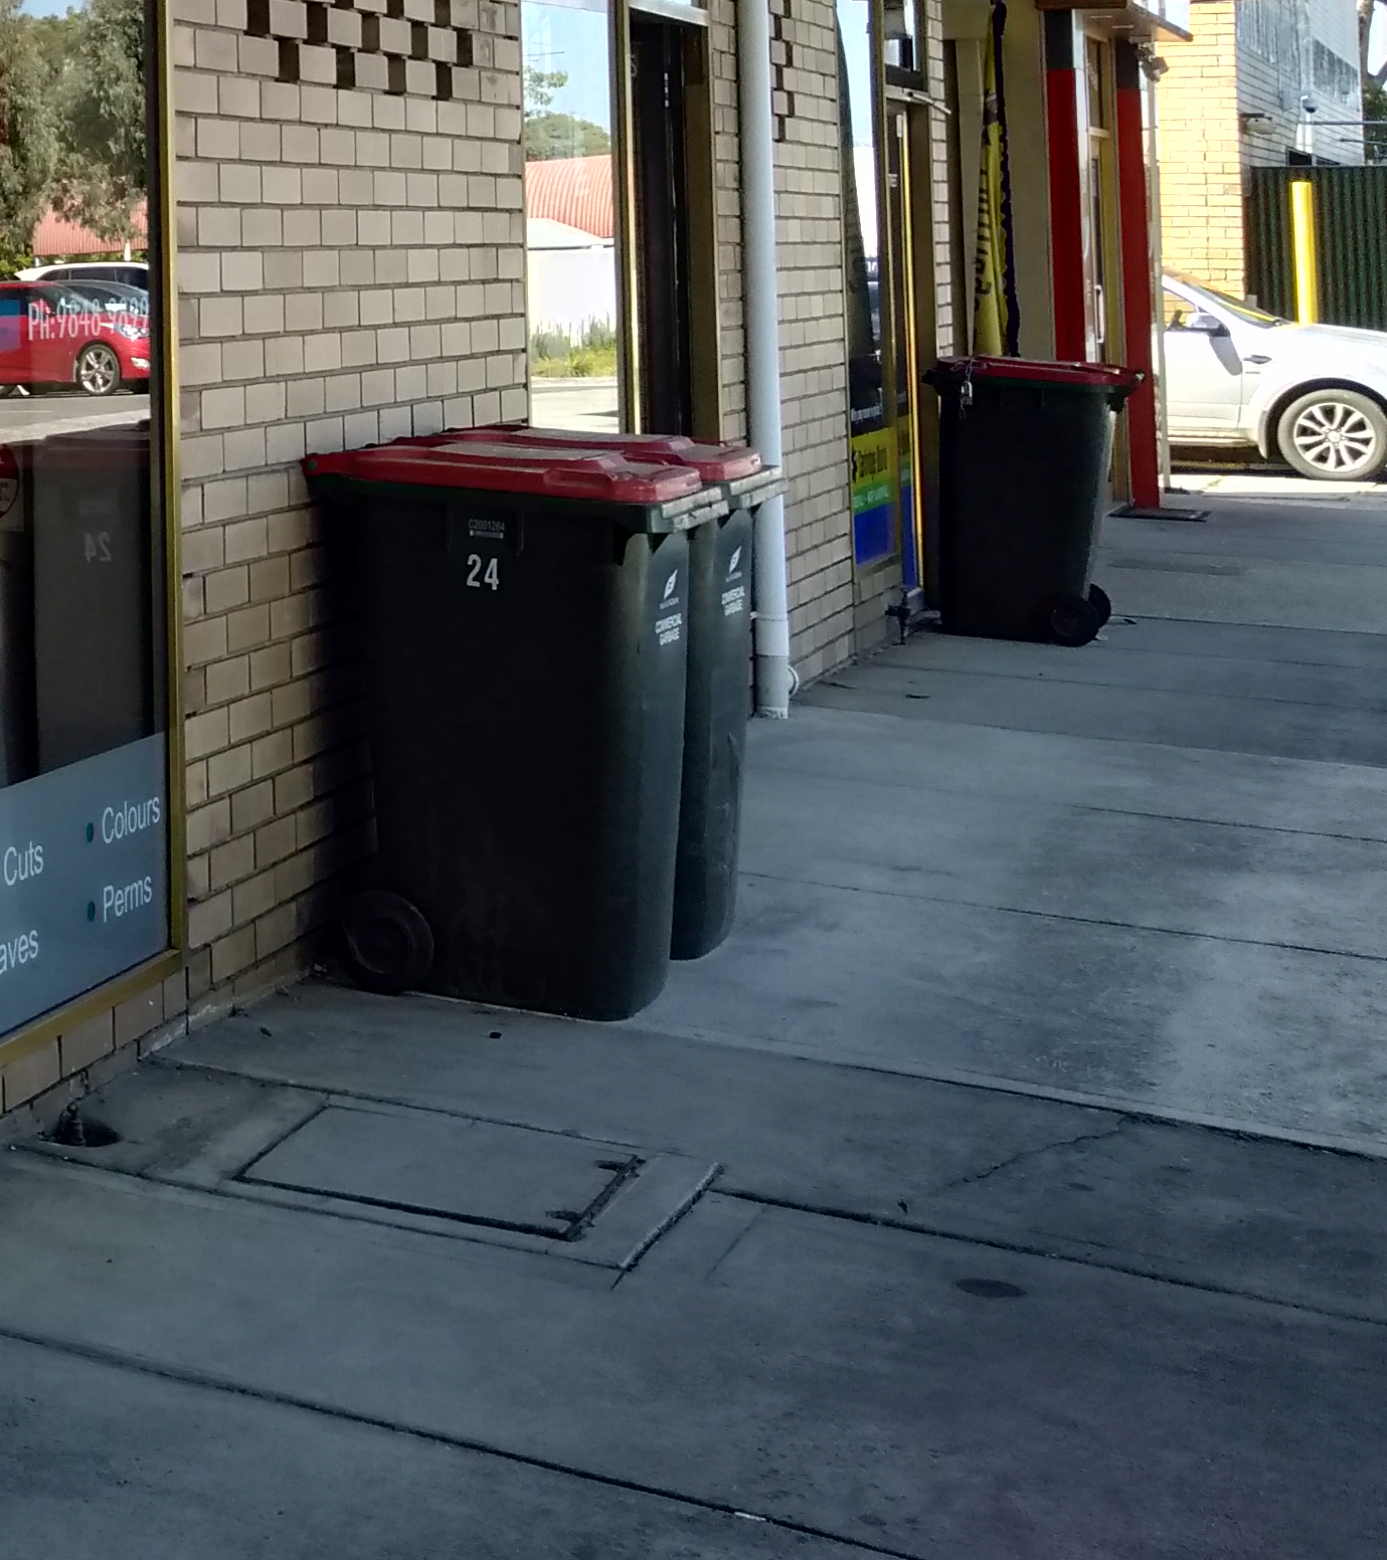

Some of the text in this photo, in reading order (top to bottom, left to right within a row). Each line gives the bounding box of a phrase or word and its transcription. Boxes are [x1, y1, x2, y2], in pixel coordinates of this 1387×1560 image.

[466, 553, 500, 591] 24
[101, 795, 161, 844] Colours
[3, 841, 44, 887] Cuts
[103, 875, 153, 923] Perms
